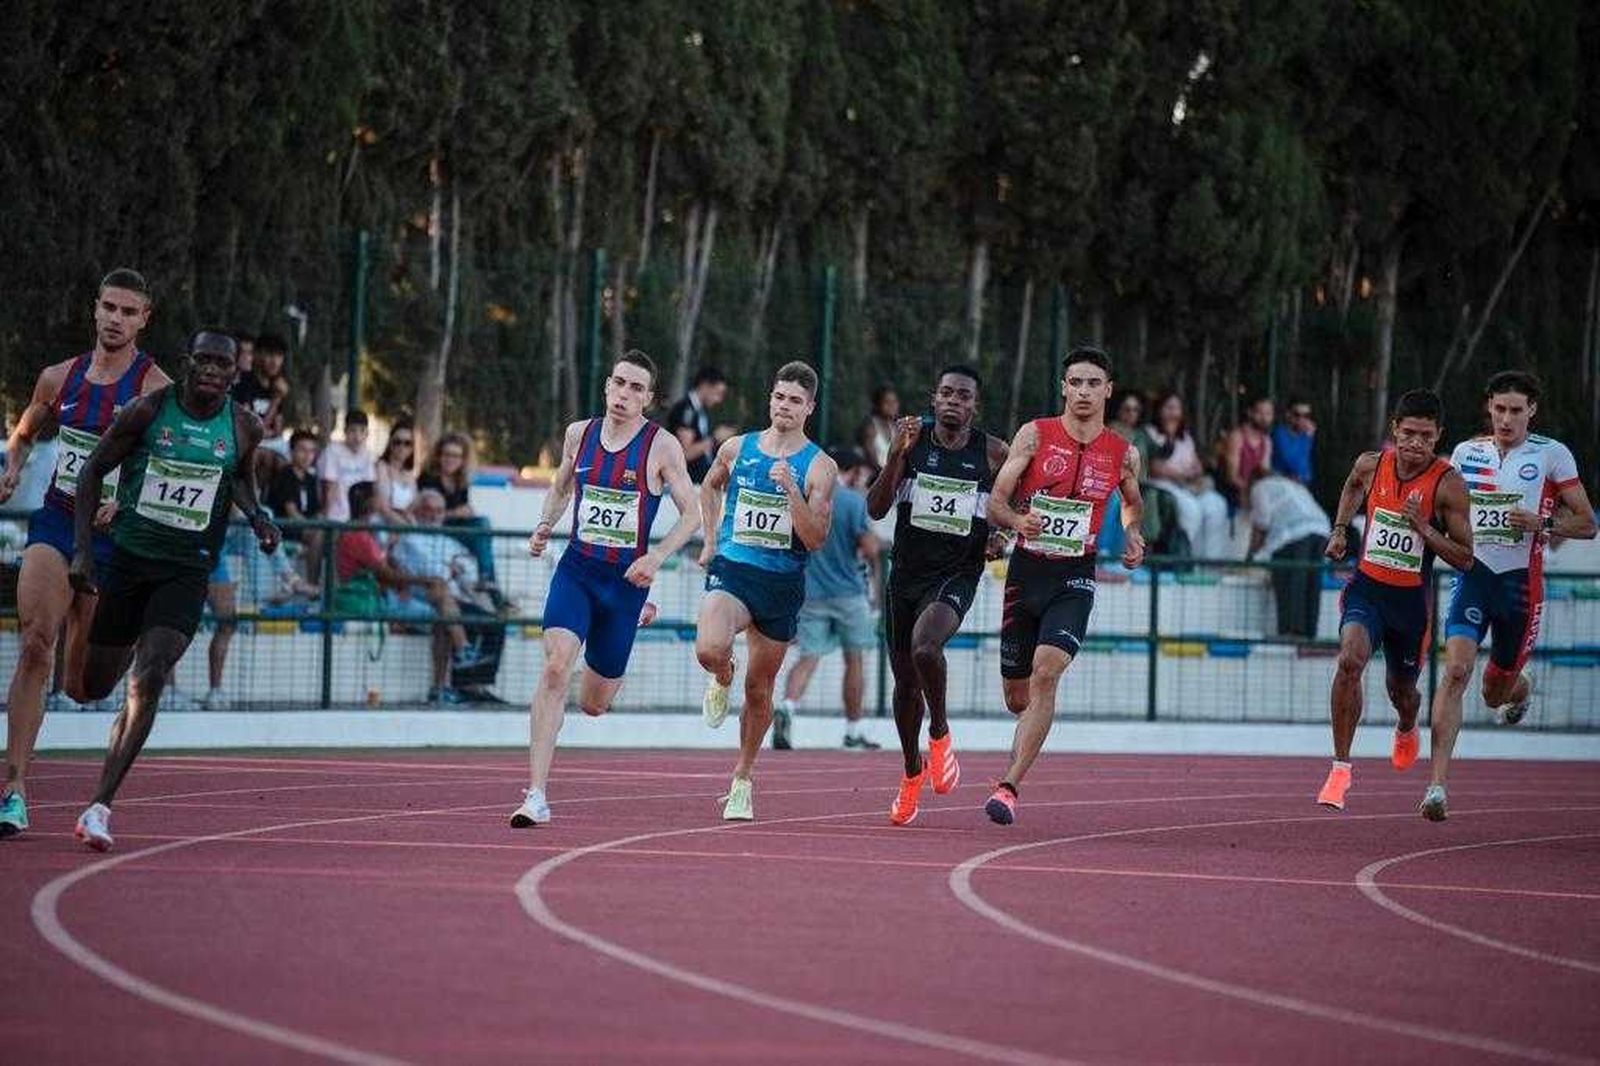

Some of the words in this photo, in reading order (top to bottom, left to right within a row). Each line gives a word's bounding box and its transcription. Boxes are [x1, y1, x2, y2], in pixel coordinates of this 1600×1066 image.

[158, 482, 203, 508] 147
[930, 495, 957, 516] 34
[587, 505, 626, 529] 267
[744, 510, 781, 531] 107
[1041, 515, 1079, 537] 287
[1376, 529, 1413, 553] 300
